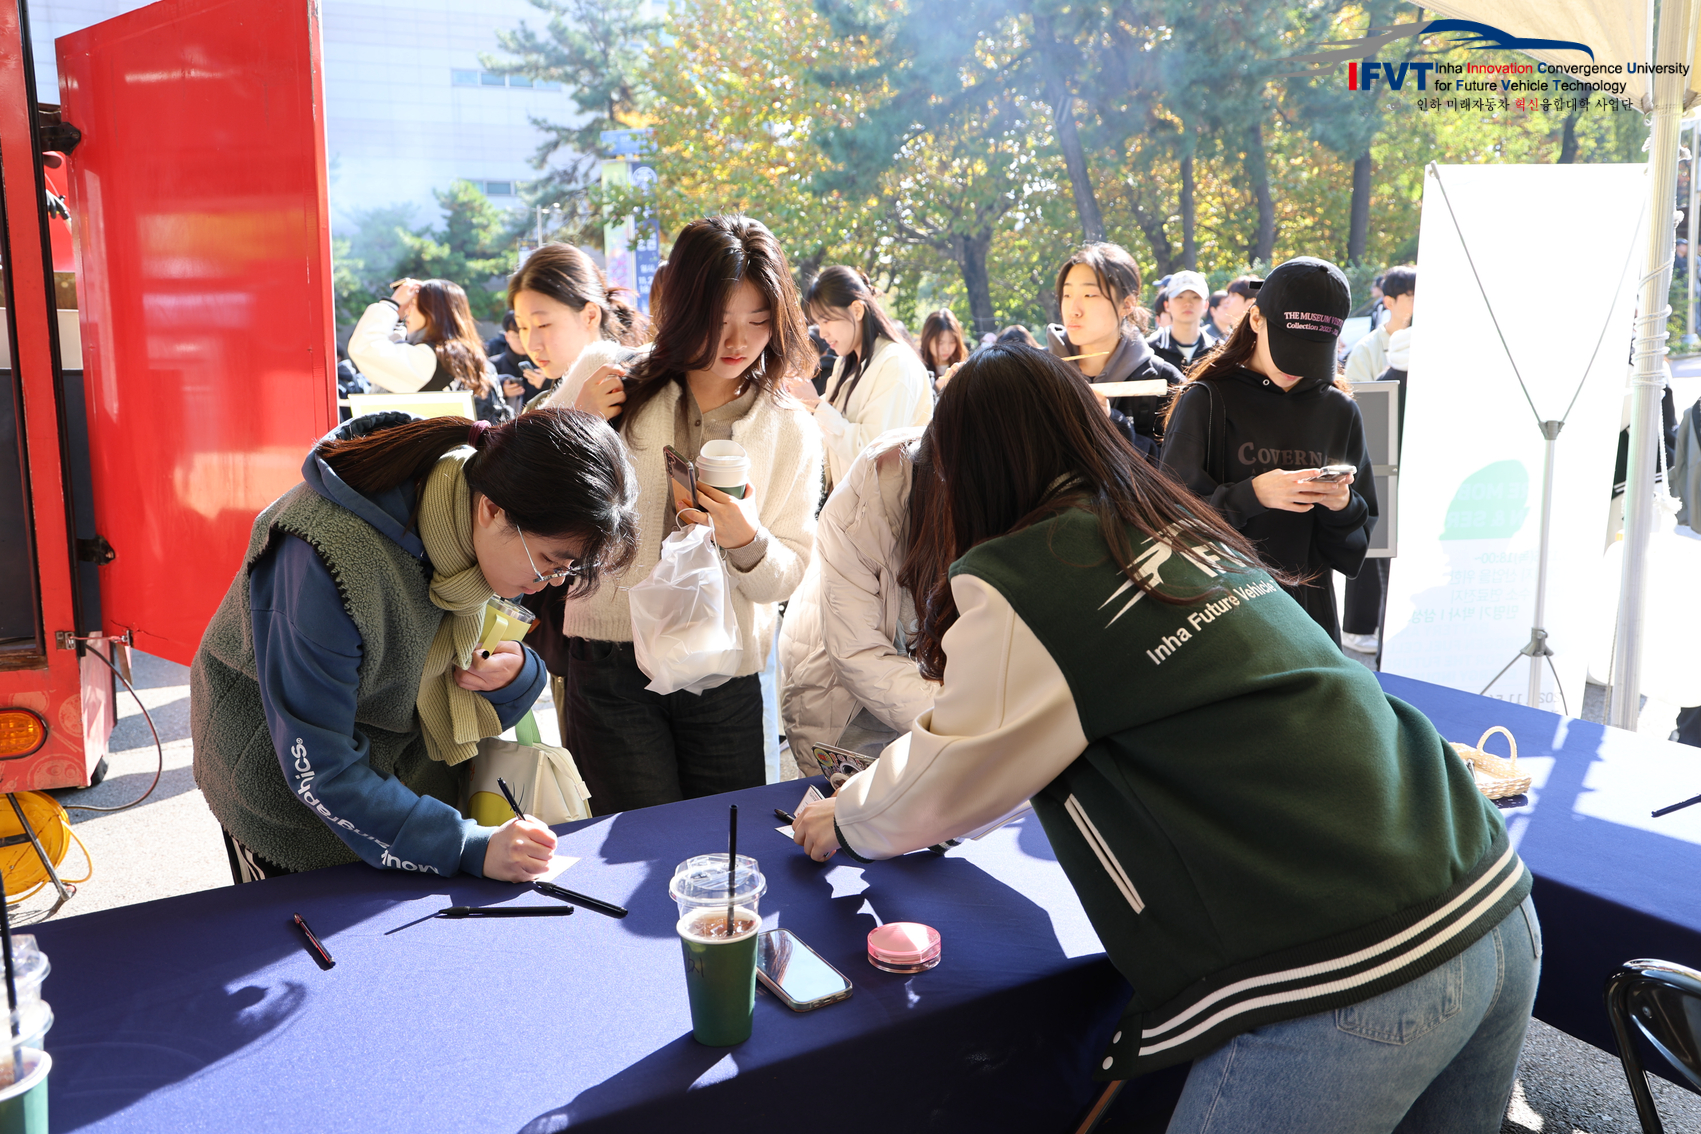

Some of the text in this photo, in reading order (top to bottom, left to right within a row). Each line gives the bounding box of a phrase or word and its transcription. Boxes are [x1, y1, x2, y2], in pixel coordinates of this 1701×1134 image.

[1283, 311, 1300, 320] THE
[1300, 312, 1332, 324] MUSEUM
[1286, 322, 1319, 331] Collection
[1237, 441, 1339, 467] COVERN
[1146, 579, 1277, 666] Inha Future Vehicle
